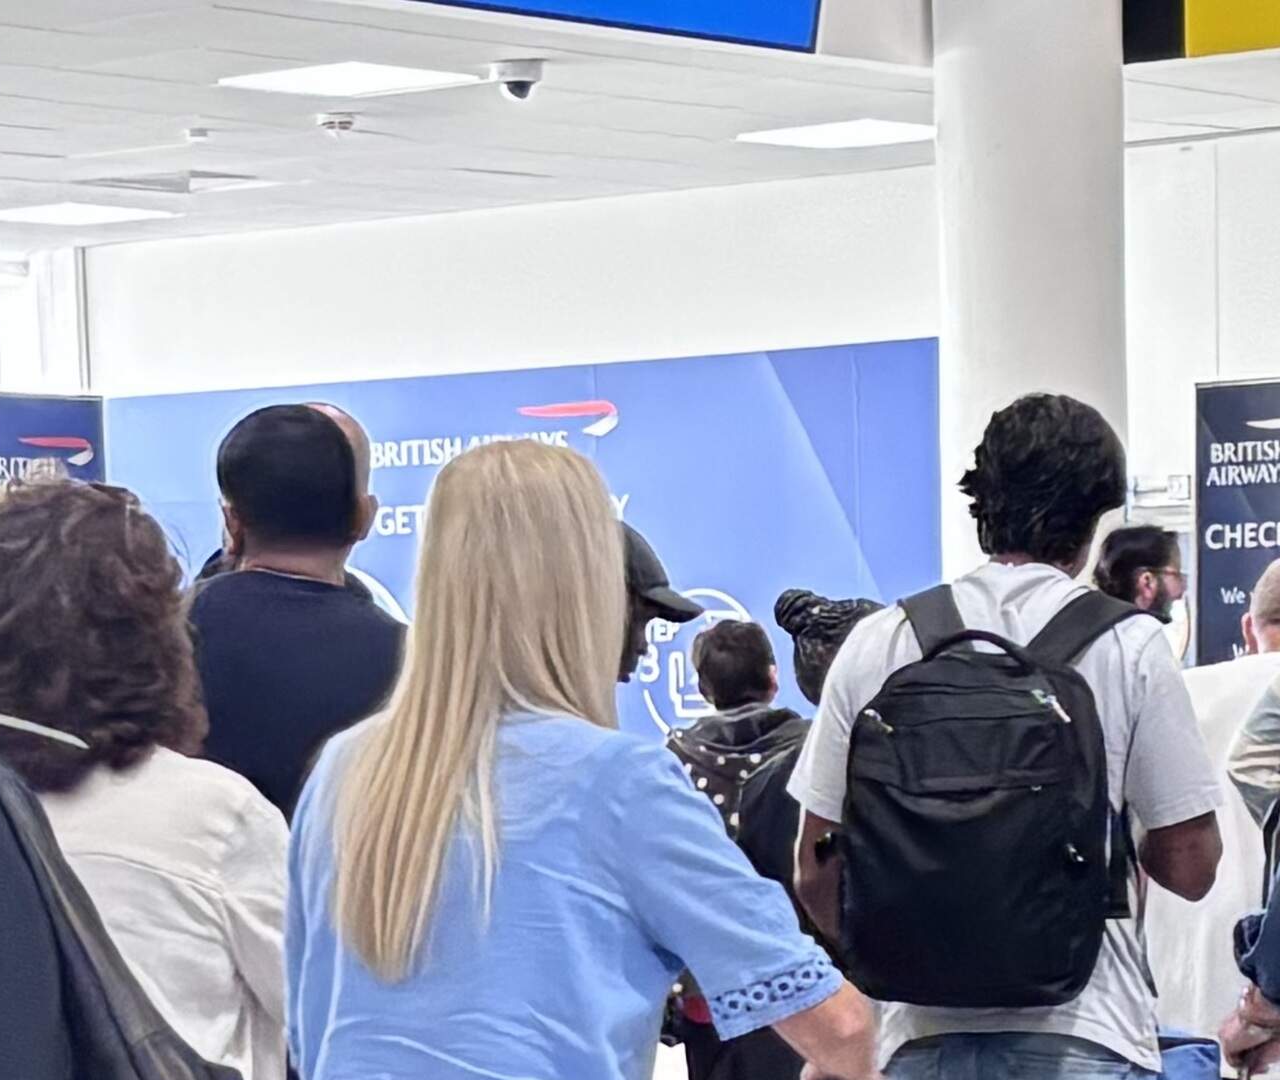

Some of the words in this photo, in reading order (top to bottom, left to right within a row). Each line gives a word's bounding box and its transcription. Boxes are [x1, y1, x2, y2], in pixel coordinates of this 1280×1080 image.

[370, 437, 461, 469] BRITISH
[376, 505, 426, 536] GET
[1221, 587, 1246, 604] We
